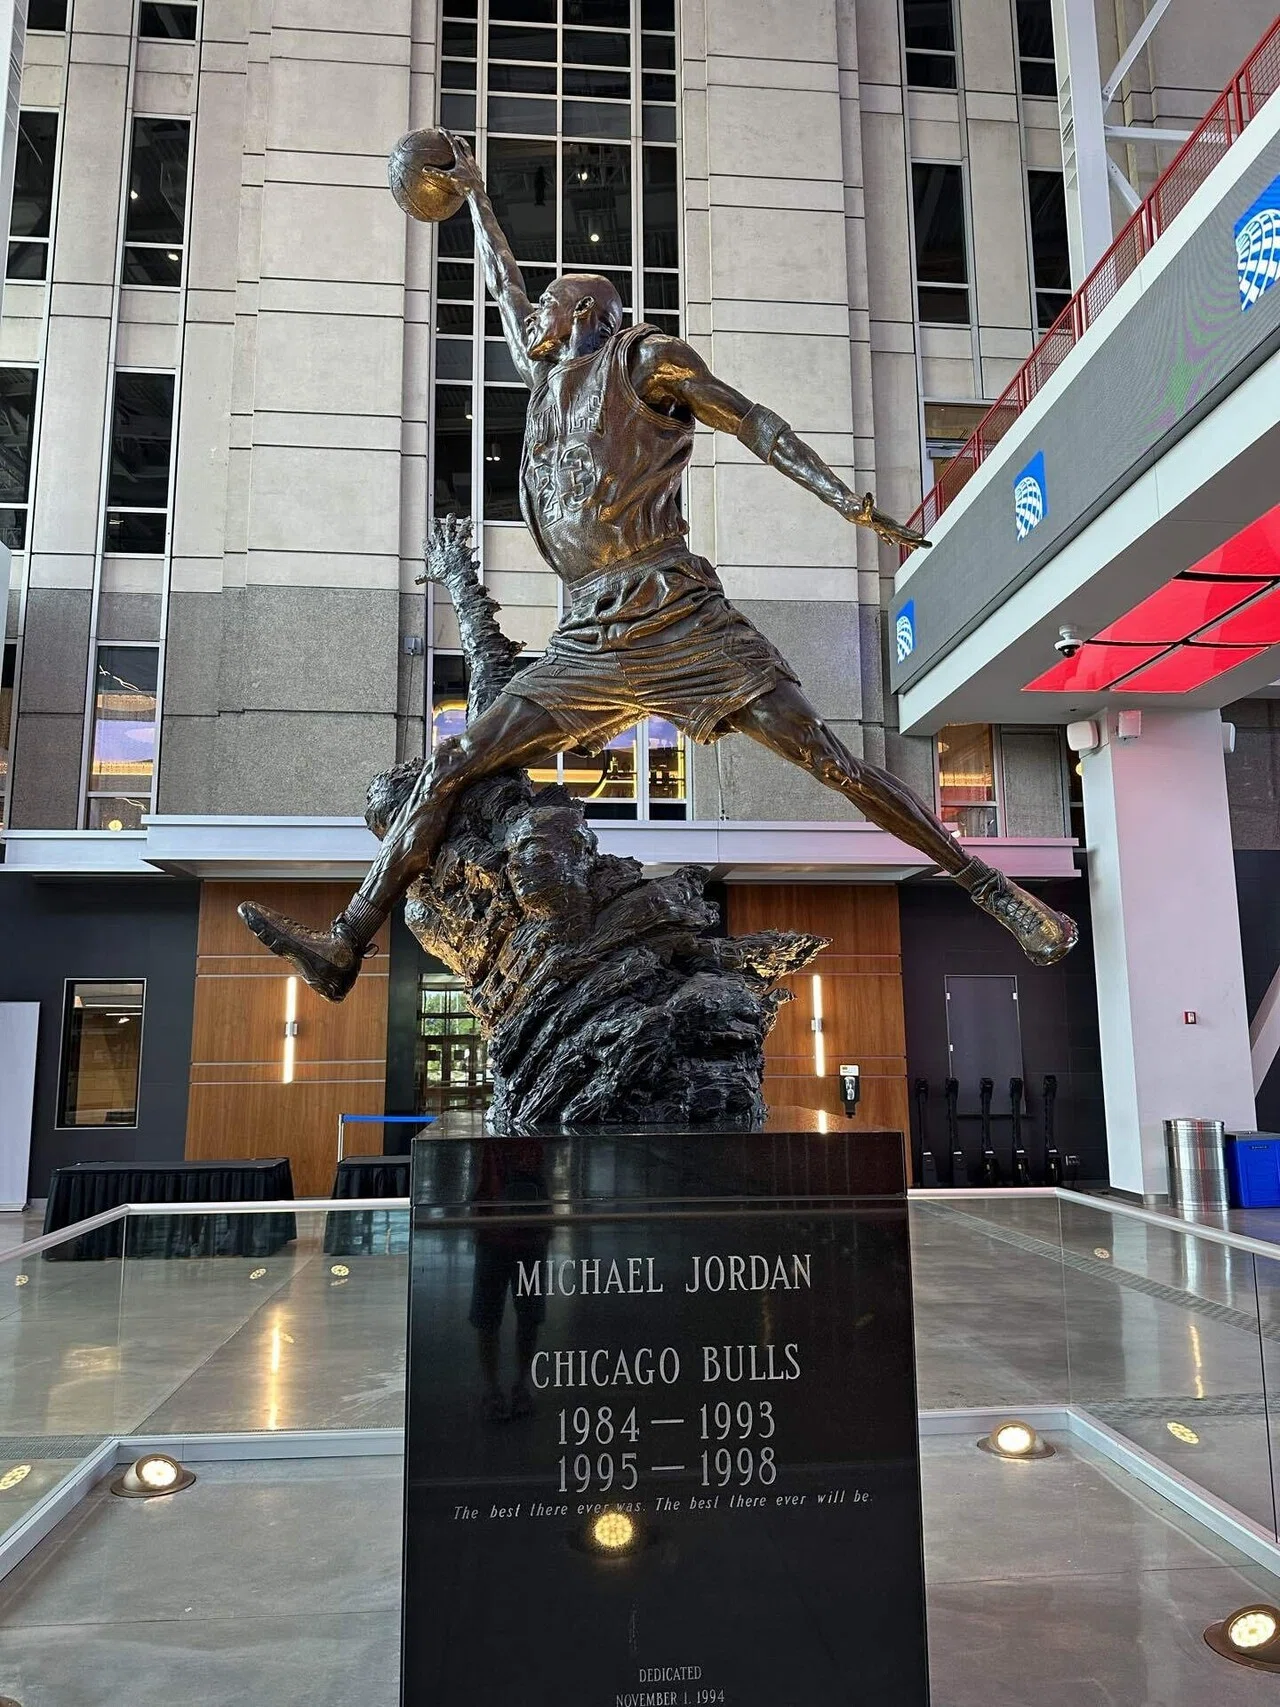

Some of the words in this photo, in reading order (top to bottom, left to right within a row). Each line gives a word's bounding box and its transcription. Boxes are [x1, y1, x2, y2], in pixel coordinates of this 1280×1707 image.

[534, 442, 597, 529] 23
[516, 1257, 664, 1297] MICHAEL
[686, 1254, 812, 1293] JORDAN
[531, 1347, 680, 1389] CHICAGO
[703, 1343, 801, 1382] BULLS
[558, 1406, 640, 1445] 1984
[700, 1401, 775, 1440] 1993
[558, 1452, 638, 1492] 1995
[701, 1446, 777, 1487] 1998
[454, 1505, 479, 1520] The
[490, 1503, 520, 1519] best
[530, 1501, 568, 1517] there
[577, 1503, 609, 1514] ever
[617, 1501, 646, 1512] was.
[656, 1496, 681, 1511] The
[690, 1495, 720, 1510] best
[729, 1493, 767, 1509] there
[776, 1494, 807, 1506] ever
[817, 1489, 846, 1504] will
[853, 1488, 873, 1503] be.
[639, 1666, 702, 1683] DEDICATED
[616, 1691, 677, 1707] NOVEMBER
[697, 1689, 725, 1704] 1994
